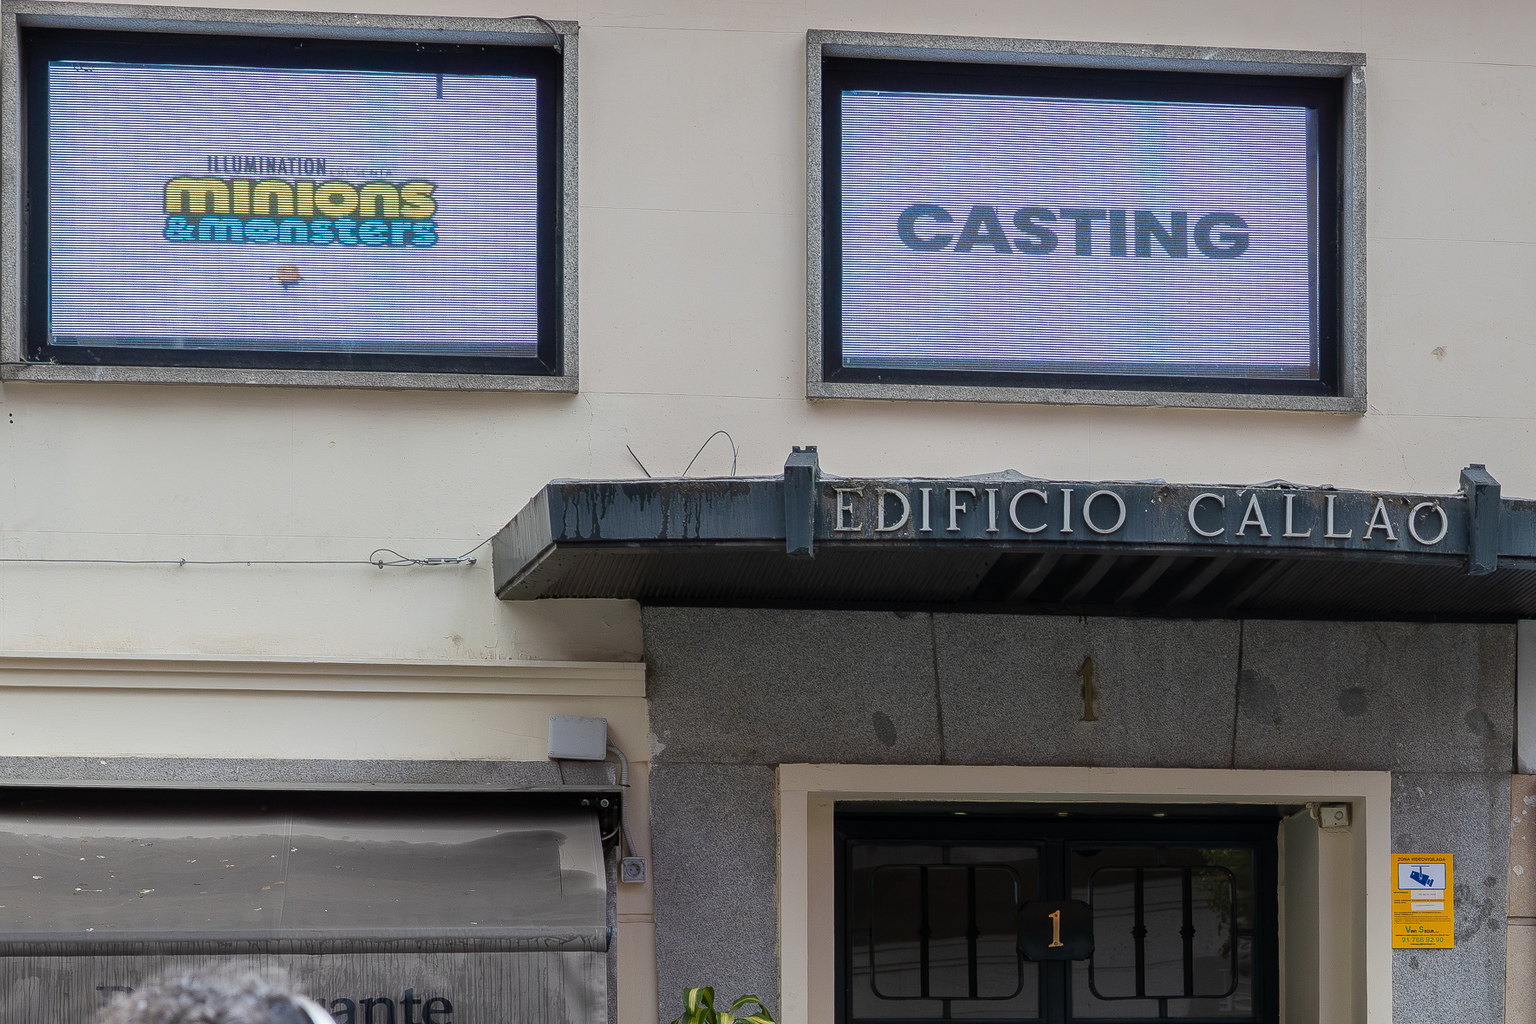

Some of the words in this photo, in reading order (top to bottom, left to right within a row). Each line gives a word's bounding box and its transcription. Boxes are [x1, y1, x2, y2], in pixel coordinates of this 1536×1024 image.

[208, 155, 327, 175] ILLUMINATION
[164, 177, 438, 218] minions
[898, 204, 1250, 259] CASTING
[833, 486, 1126, 535] EDIFICIO
[1188, 493, 1449, 546] CALLAO
[1048, 909, 1064, 948] 1
